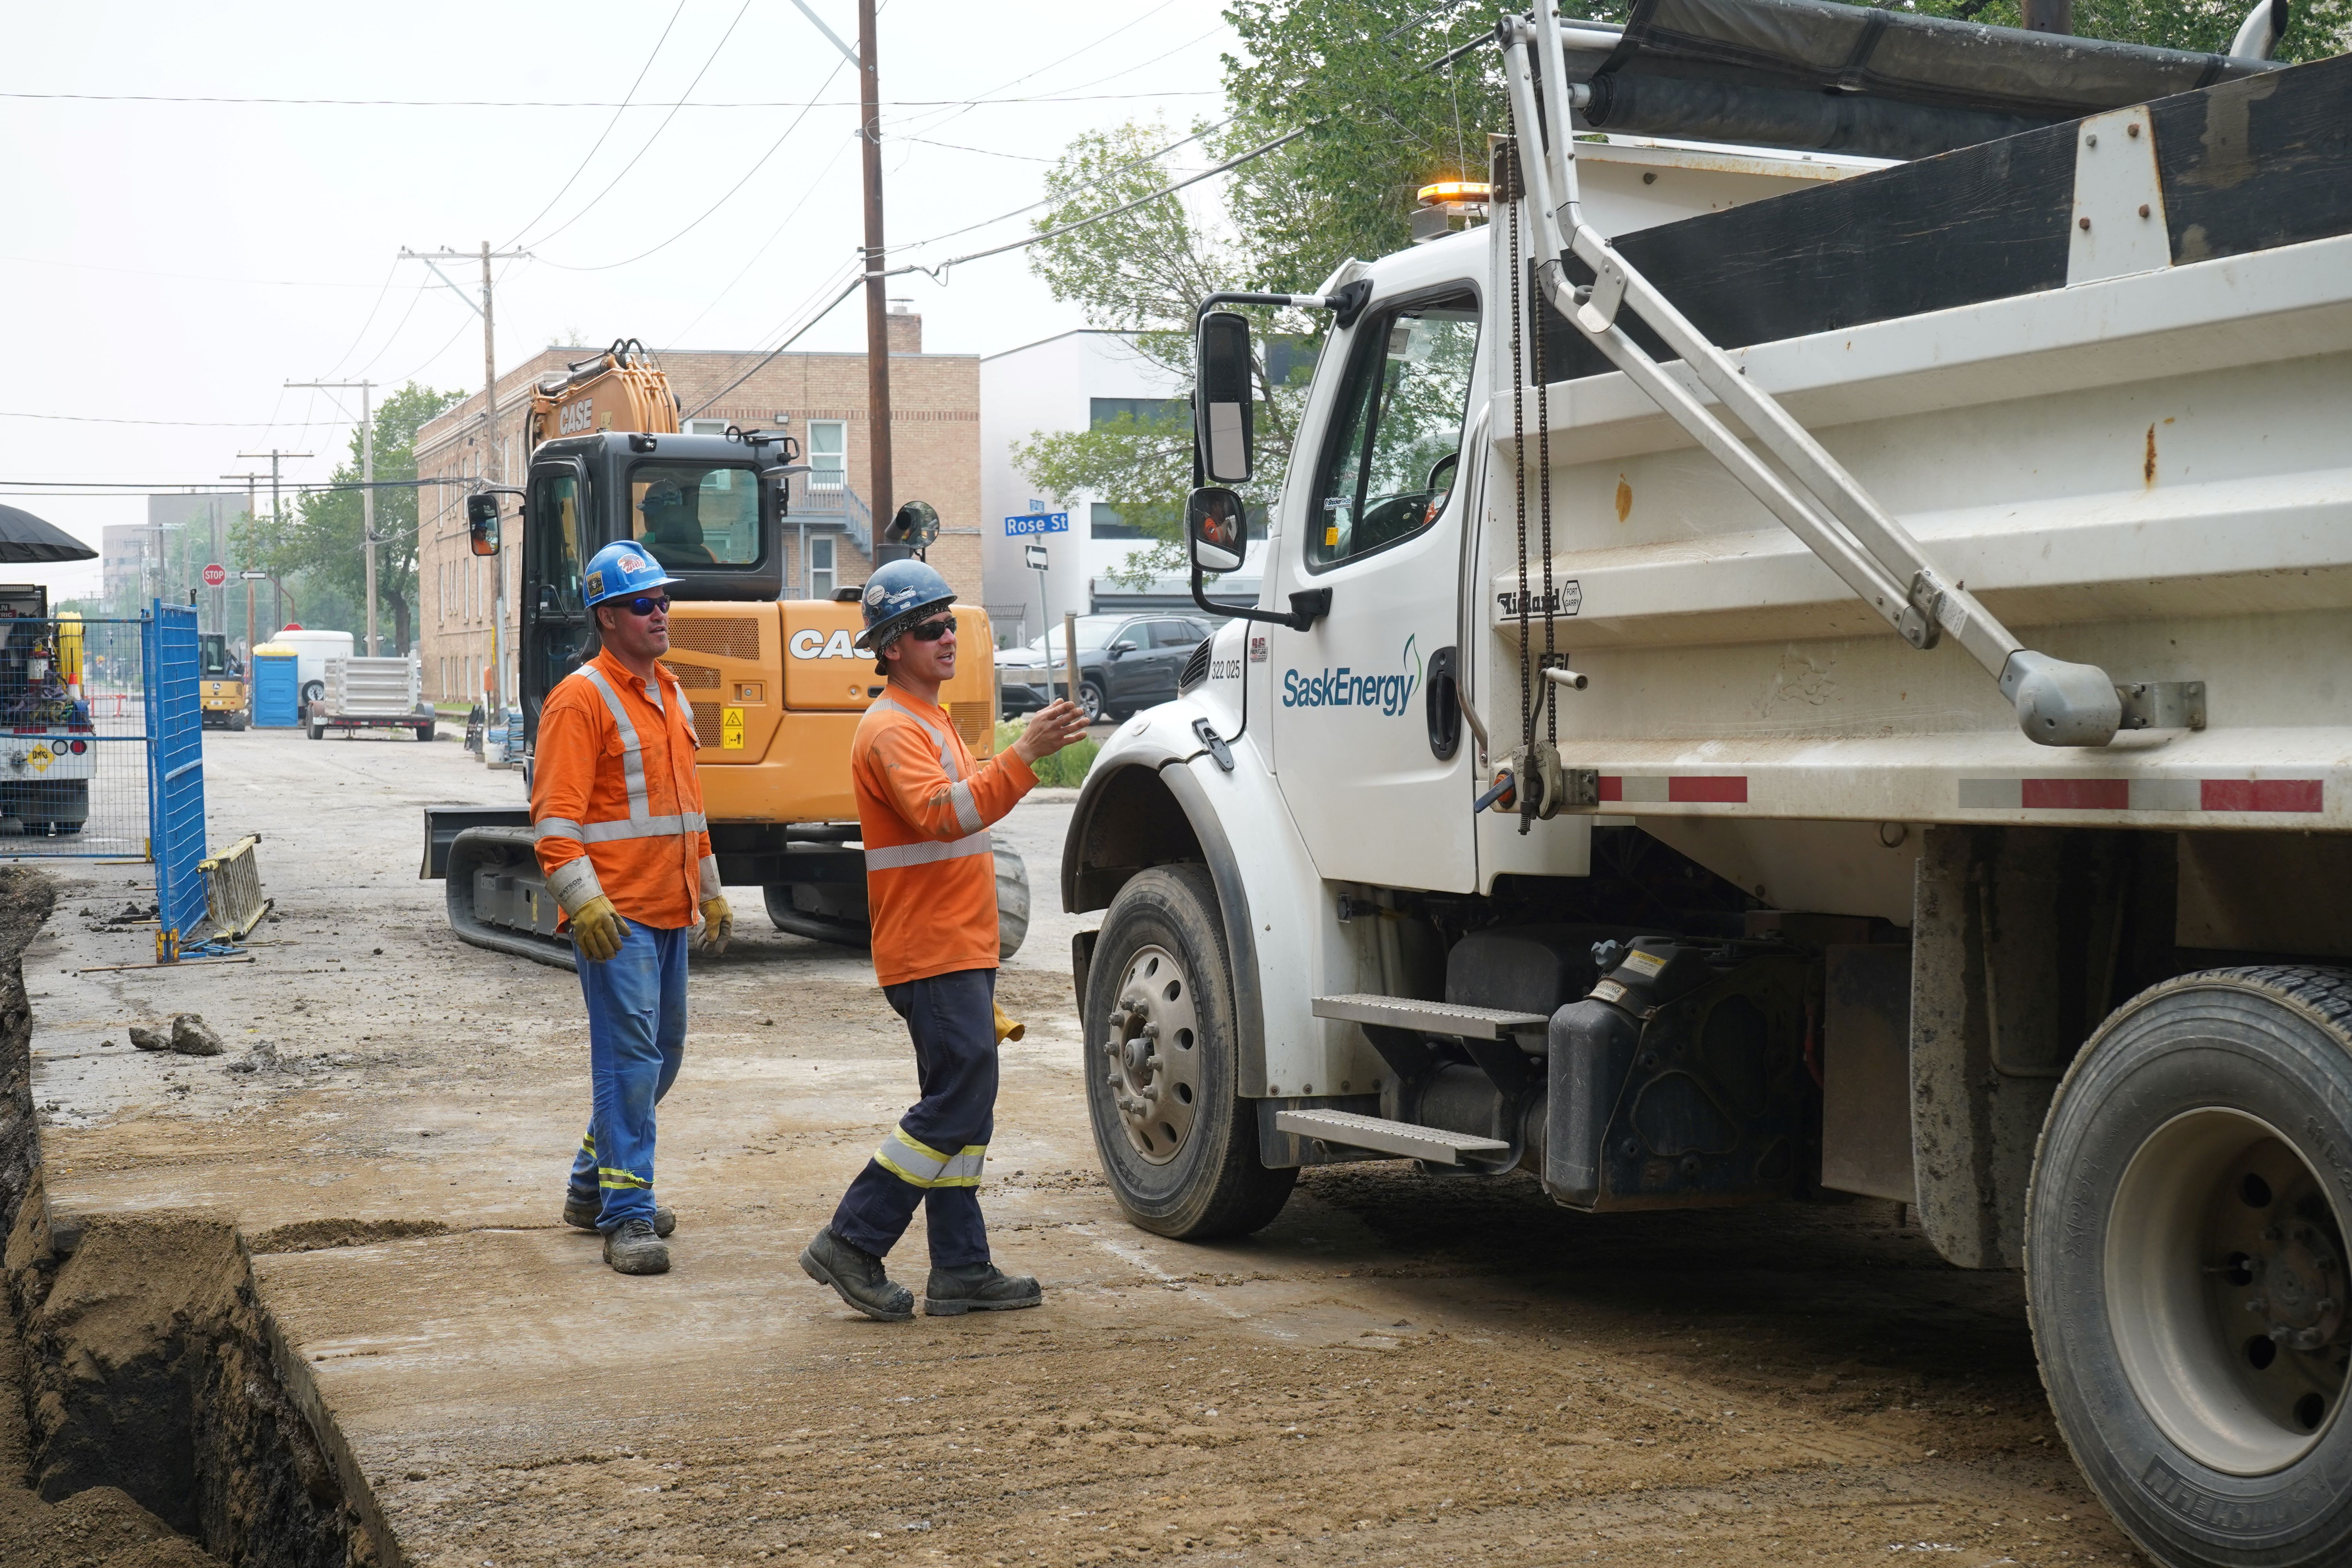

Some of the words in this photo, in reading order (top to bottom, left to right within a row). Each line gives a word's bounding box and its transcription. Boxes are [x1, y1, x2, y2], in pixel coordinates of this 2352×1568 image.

[560, 397, 592, 436] CASE
[1007, 519, 1045, 534] Rose
[1051, 515, 1067, 530] St
[205, 570, 224, 580] STOP
[1497, 588, 1560, 615] Milad
[789, 629, 877, 659] CAS
[1212, 661, 1224, 679] 322
[1227, 660, 1240, 679] 025
[1283, 668, 1414, 716] SaskEnergy
[559, 877, 583, 898] WATSON
[1638, 954, 1659, 963] CAUTION
[1598, 982, 1621, 993] ARNING
[2144, 1467, 2291, 1529] MICHELIN
